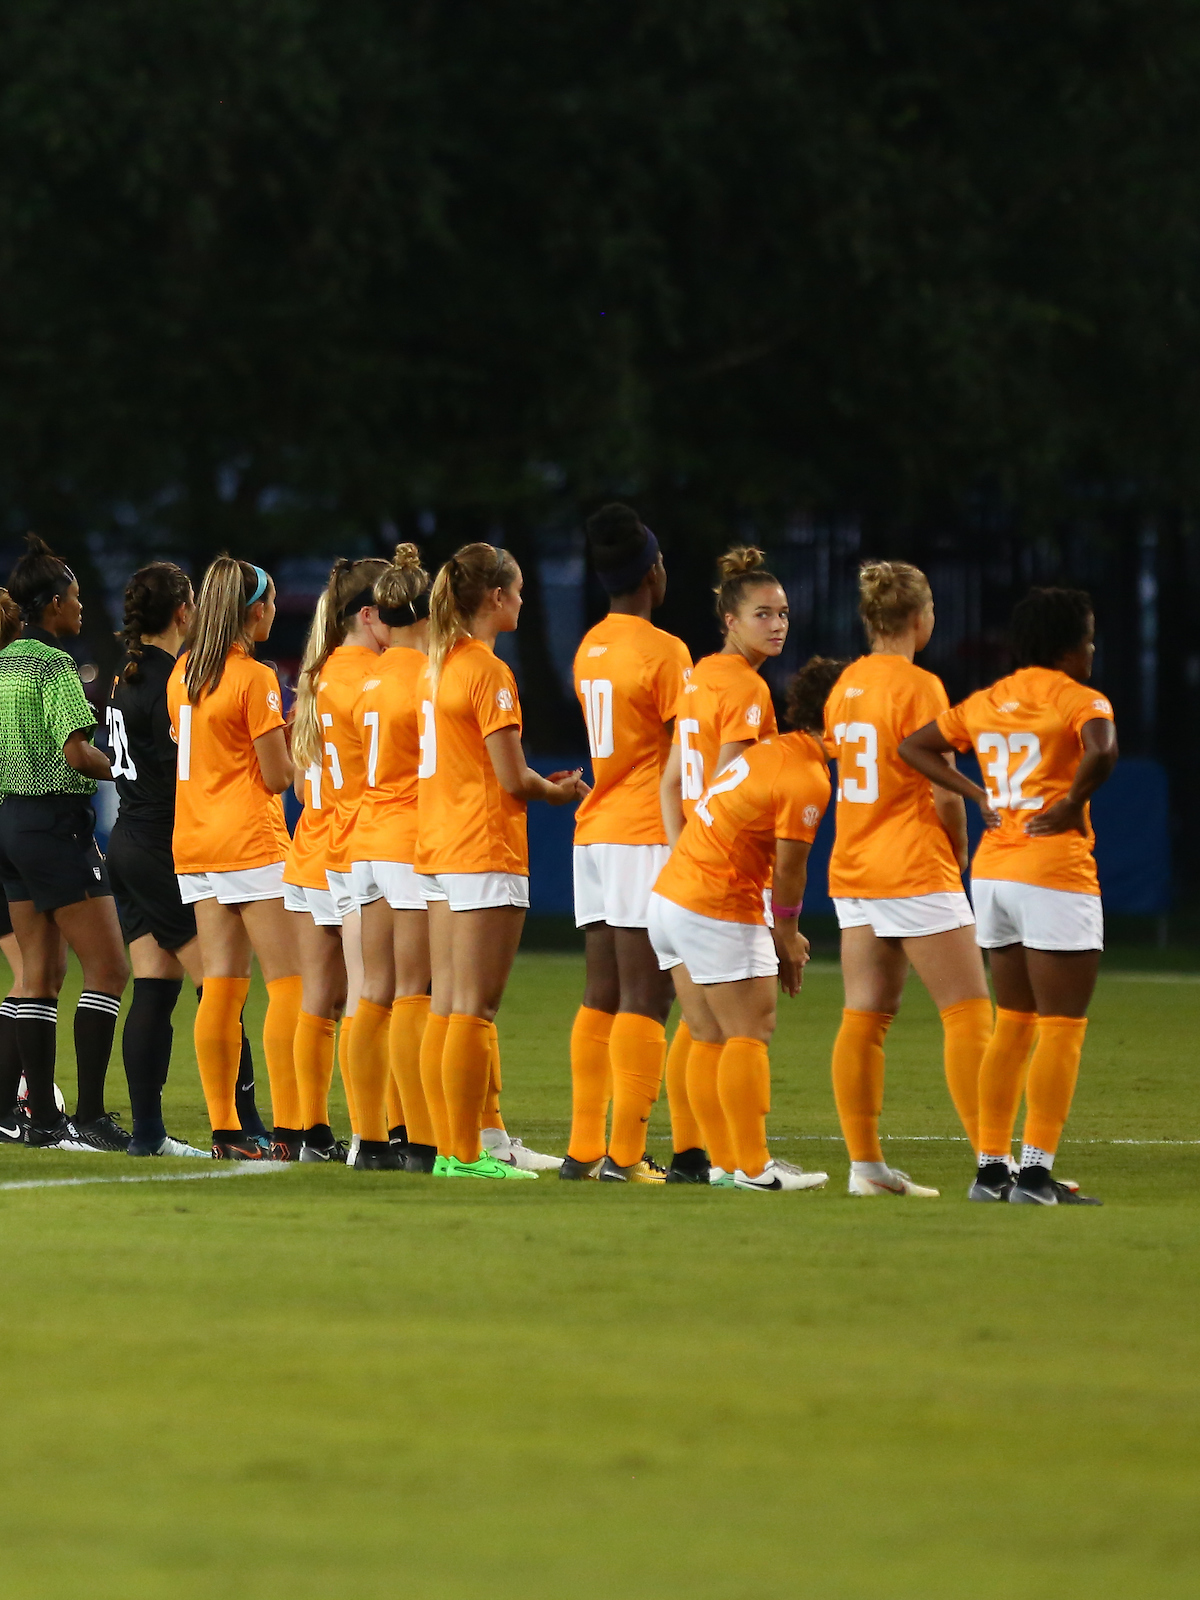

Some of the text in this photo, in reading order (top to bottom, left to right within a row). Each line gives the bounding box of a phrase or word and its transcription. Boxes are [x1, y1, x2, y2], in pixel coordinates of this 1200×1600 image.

[363, 711, 379, 788] 7
[580, 679, 615, 759] 10
[977, 733, 1045, 811] 32
